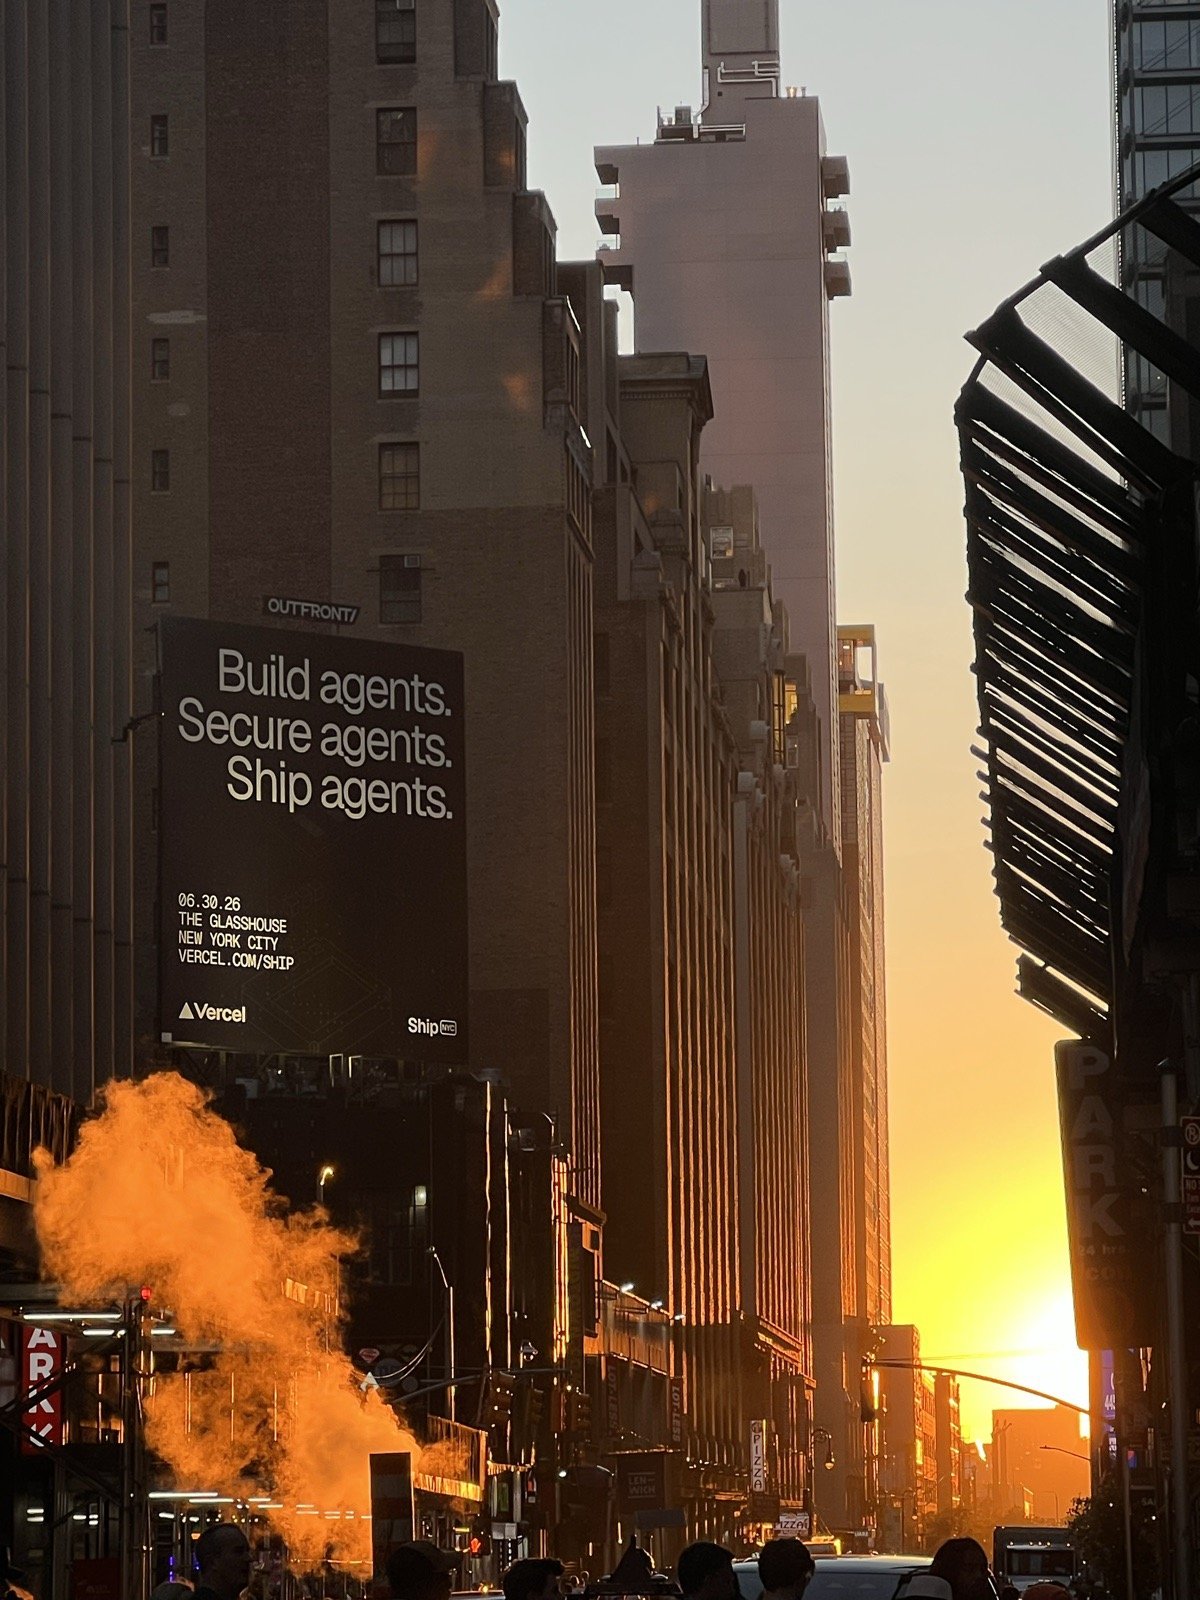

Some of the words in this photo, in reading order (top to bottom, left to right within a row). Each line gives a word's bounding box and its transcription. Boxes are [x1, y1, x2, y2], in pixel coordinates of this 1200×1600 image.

[218, 648, 310, 701] Build
[319, 671, 452, 717] agents.
[178, 697, 312, 753] Secure
[320, 723, 452, 768] agents.
[227, 755, 313, 813] Ship
[320, 775, 453, 820] agents.
[178, 893, 241, 912] 06.30.26
[178, 911, 203, 927] THE
[209, 913, 287, 934] GLASSHOUSE
[178, 930, 203, 946] NEW
[209, 932, 241, 949] YORK
[247, 935, 279, 951] CITY
[178, 949, 295, 971] VERCEL.COM/SHIP
[193, 1002, 246, 1023] Vercel
[407, 1017, 439, 1037] Ship
[1068, 1046, 1126, 1237] PARK
[753, 1434, 763, 1489] PIZZA
